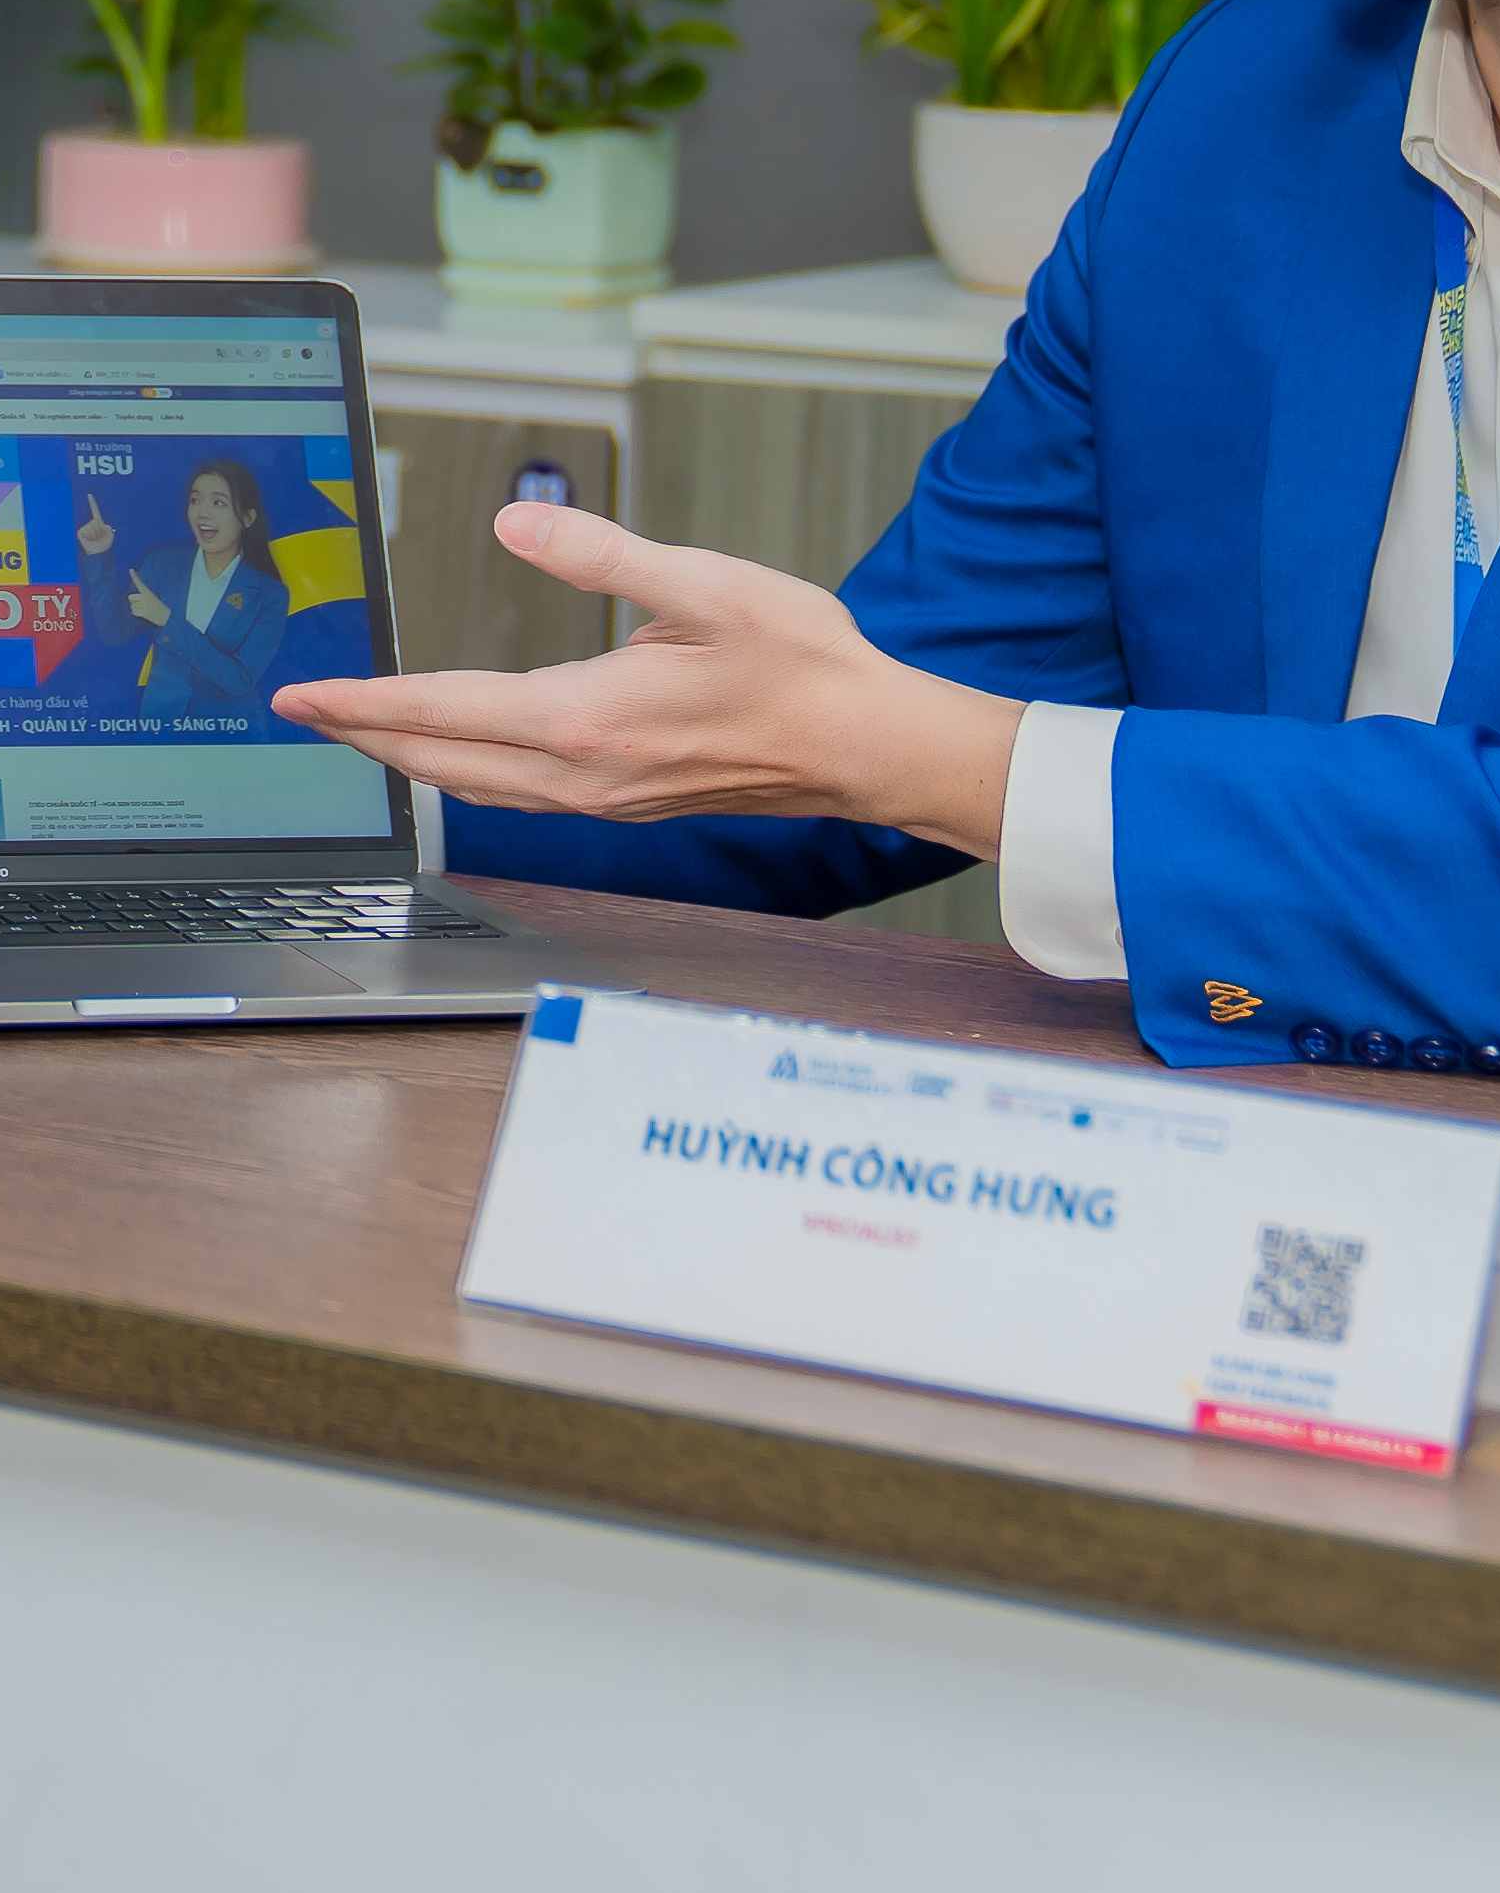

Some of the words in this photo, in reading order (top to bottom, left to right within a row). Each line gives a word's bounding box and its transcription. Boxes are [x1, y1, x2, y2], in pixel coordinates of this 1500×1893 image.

[77, 455, 133, 475] HSU
[31, 587, 71, 618] TỶ
[9, 696, 43, 711] hàng
[45, 695, 70, 708] đầu
[22, 715, 68, 733] QUẢN
[71, 715, 87, 732] LÝ
[100, 718, 138, 735] DỊCH
[139, 718, 161, 735] VỤ
[173, 716, 215, 732] SÁNG
[217, 718, 248, 735] TẠO
[643, 1115, 811, 1179] HUỲNH
[821, 1141, 957, 1204] CÔNG
[970, 1168, 1118, 1230] HƯNG
